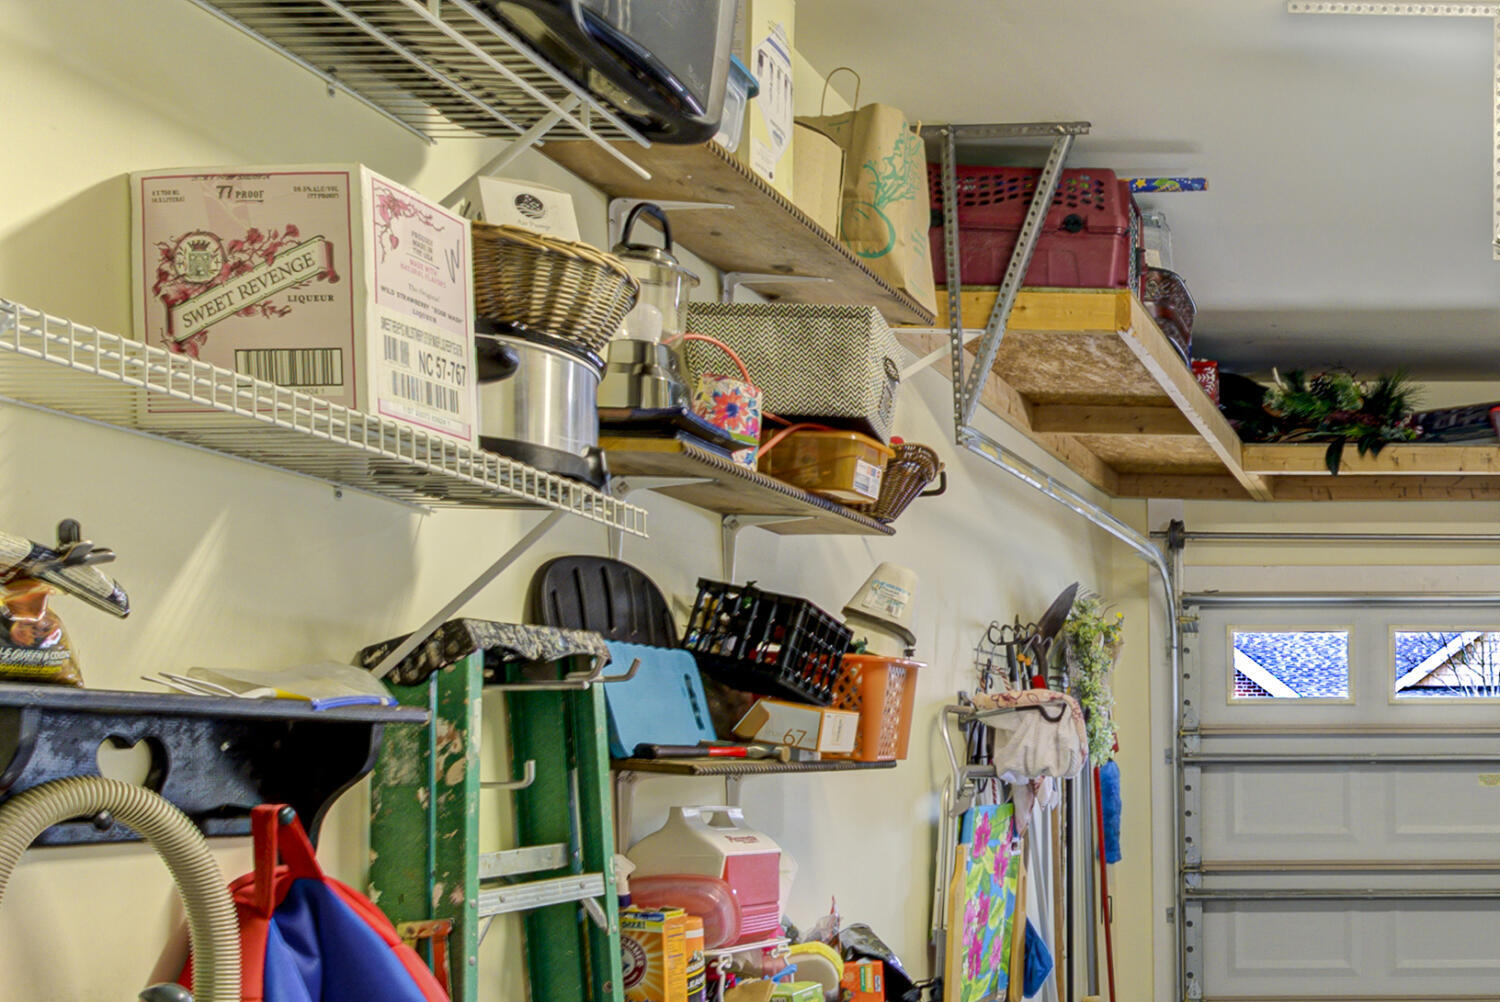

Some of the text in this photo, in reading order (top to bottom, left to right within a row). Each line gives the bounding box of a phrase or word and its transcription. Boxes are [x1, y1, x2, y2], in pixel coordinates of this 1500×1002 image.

[216, 185, 265, 200] 77 PROOF
[182, 251, 316, 329] SWEET REVENGE
[287, 295, 335, 304] LIQUEUR
[419, 350, 466, 387] NC 57-767
[783, 728, 807, 748] 67
